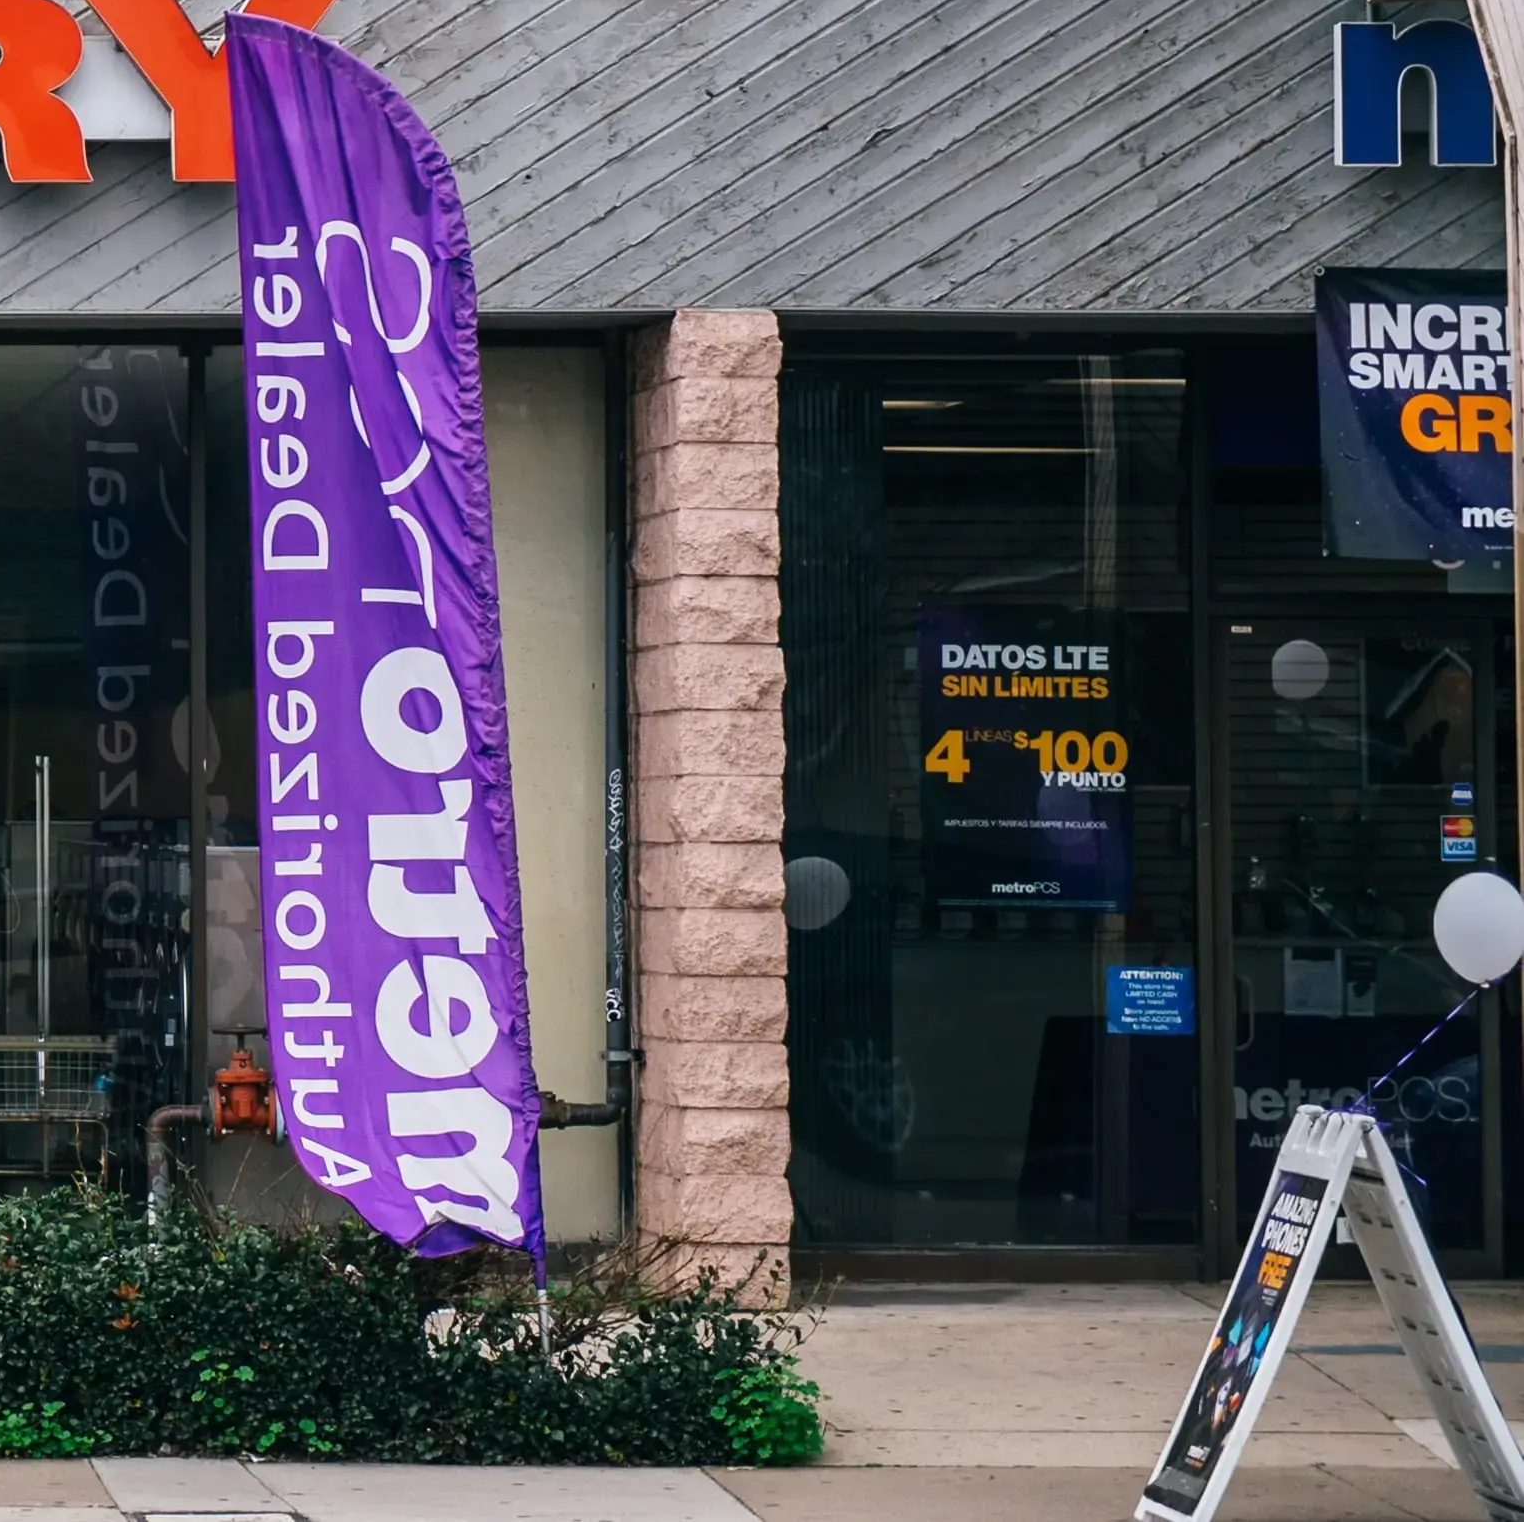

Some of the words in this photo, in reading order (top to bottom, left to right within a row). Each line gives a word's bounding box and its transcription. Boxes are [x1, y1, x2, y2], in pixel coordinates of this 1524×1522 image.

[941, 644, 1047, 670] DATOS
[1054, 646, 1110, 671] LTE
[941, 675, 989, 698] SIN
[994, 671, 1110, 699] LÍMITES
[925, 729, 971, 783] 4
[1040, 771, 1056, 787] Y
[1058, 771, 1127, 788] PUNTO
[944, 819, 990, 828] IMPUESTOS
[998, 820, 1029, 829] TARIFAS
[1029, 820, 1064, 830] SIEMPRE
[1447, 841, 1474, 852] VISA
[991, 881, 1062, 895] metroPCS
[1151, 1016, 1183, 1024] ACCESS
[1271, 1191, 1319, 1226] AMAZING
[1260, 1218, 1309, 1257] PHONES
